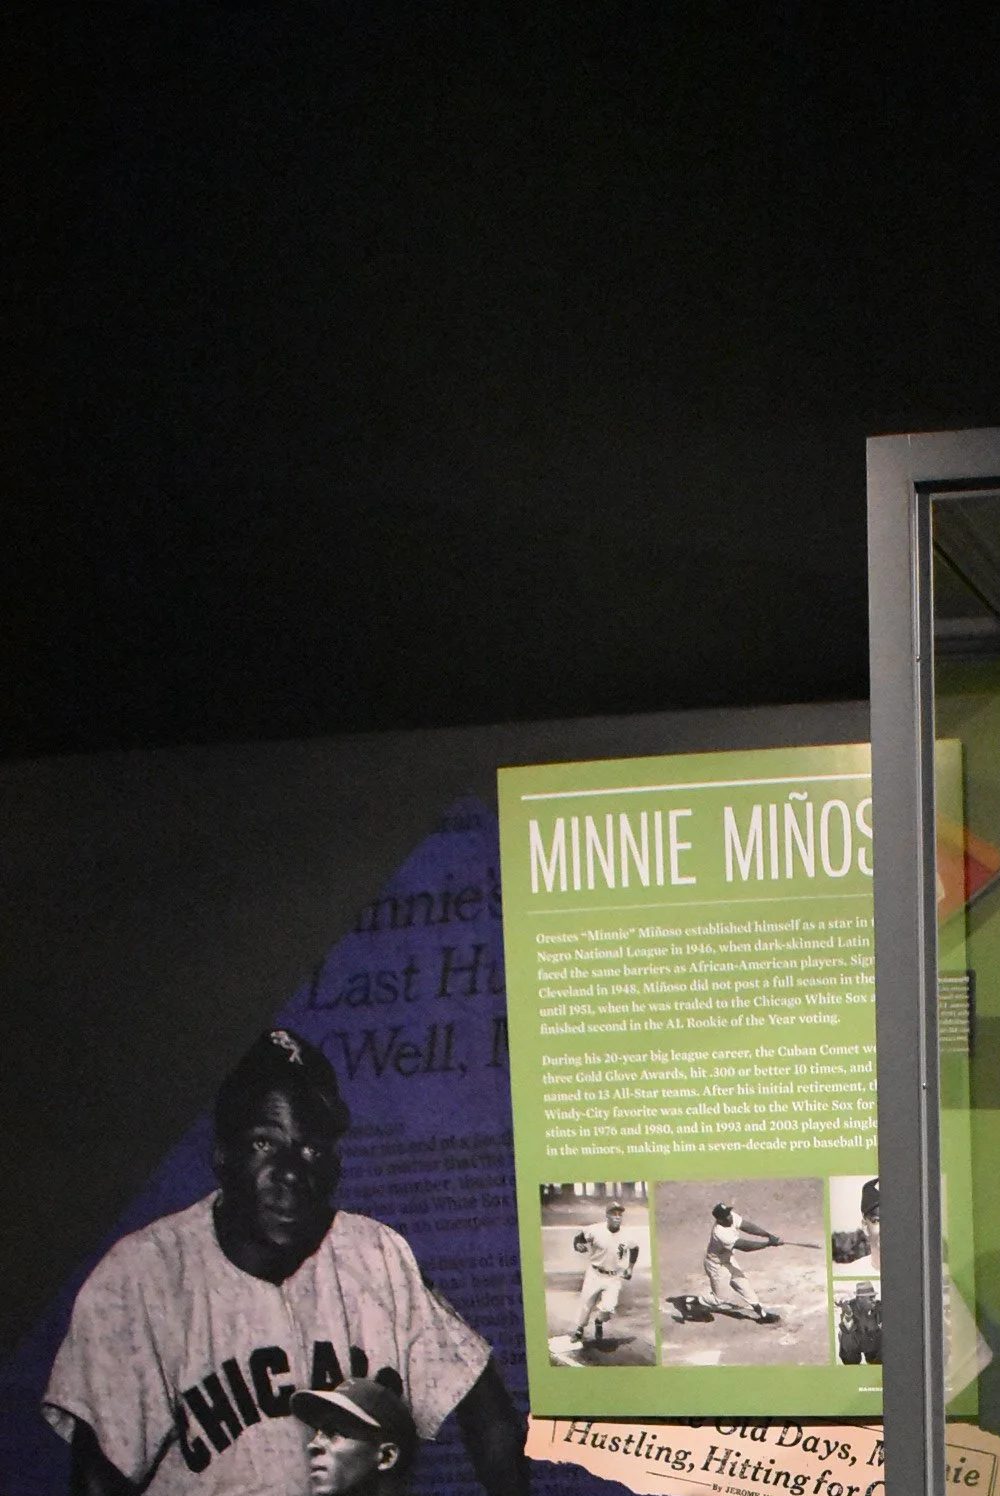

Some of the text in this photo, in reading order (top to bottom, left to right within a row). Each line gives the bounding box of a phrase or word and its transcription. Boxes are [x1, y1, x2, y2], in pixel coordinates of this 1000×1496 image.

[529, 808, 696, 894] MINNIE
[536, 931, 578, 944] Orestes
[638, 925, 682, 939] Miñoso
[684, 922, 751, 936] established
[754, 919, 800, 933] himself
[802, 921, 815, 930] as
[818, 921, 825, 929] a
[828, 916, 852, 929] star
[856, 916, 867, 927] in
[537, 948, 572, 963] Negro
[575, 946, 623, 959] National
[626, 944, 668, 959] League
[671, 944, 682, 955] in
[719, 941, 751, 953] when
[754, 937, 834, 952] dark-skinned
[838, 936, 869, 948] Latin
[538, 955, 846, 980] faced the same barriers as African-American players.
[539, 984, 593, 998] Cleveland
[596, 984, 608, 995] in
[643, 980, 687, 993] Miñoso
[690, 979, 708, 991] did
[712, 978, 731, 990] not
[735, 977, 759, 991] post
[763, 980, 769, 988] a
[773, 976, 793, 988] full
[797, 977, 836, 987] season
[840, 973, 852, 985] in
[855, 972, 874, 984] the
[540, 1004, 566, 1016] until
[598, 1002, 628, 1014] when
[632, 1001, 646, 1012] he
[648, 1003, 671, 1012] was
[674, 998, 712, 1011] traded
[716, 997, 728, 1009] to
[731, 996, 749, 1008] the
[753, 994, 801, 1009] Chicago
[805, 992, 841, 1005] White
[845, 991, 866, 1003] Sox
[540, 1021, 585, 1034] finished
[587, 1020, 626, 1032] second
[630, 1019, 640, 1031] in
[644, 1018, 663, 1030] the
[687, 1016, 727, 1028] Rookie
[730, 1015, 743, 1027] of
[745, 1014, 764, 1026] the
[768, 1013, 795, 1025] Year
[799, 1011, 839, 1026] voting.
[542, 1043, 859, 1068] During his 20-year big league career, the Cuban Comet
[775, 1421, 859, 1468] Days,
[563, 1420, 695, 1473] Hustling,
[701, 1445, 811, 1496] Hitting
[712, 1483, 723, 1493] By
